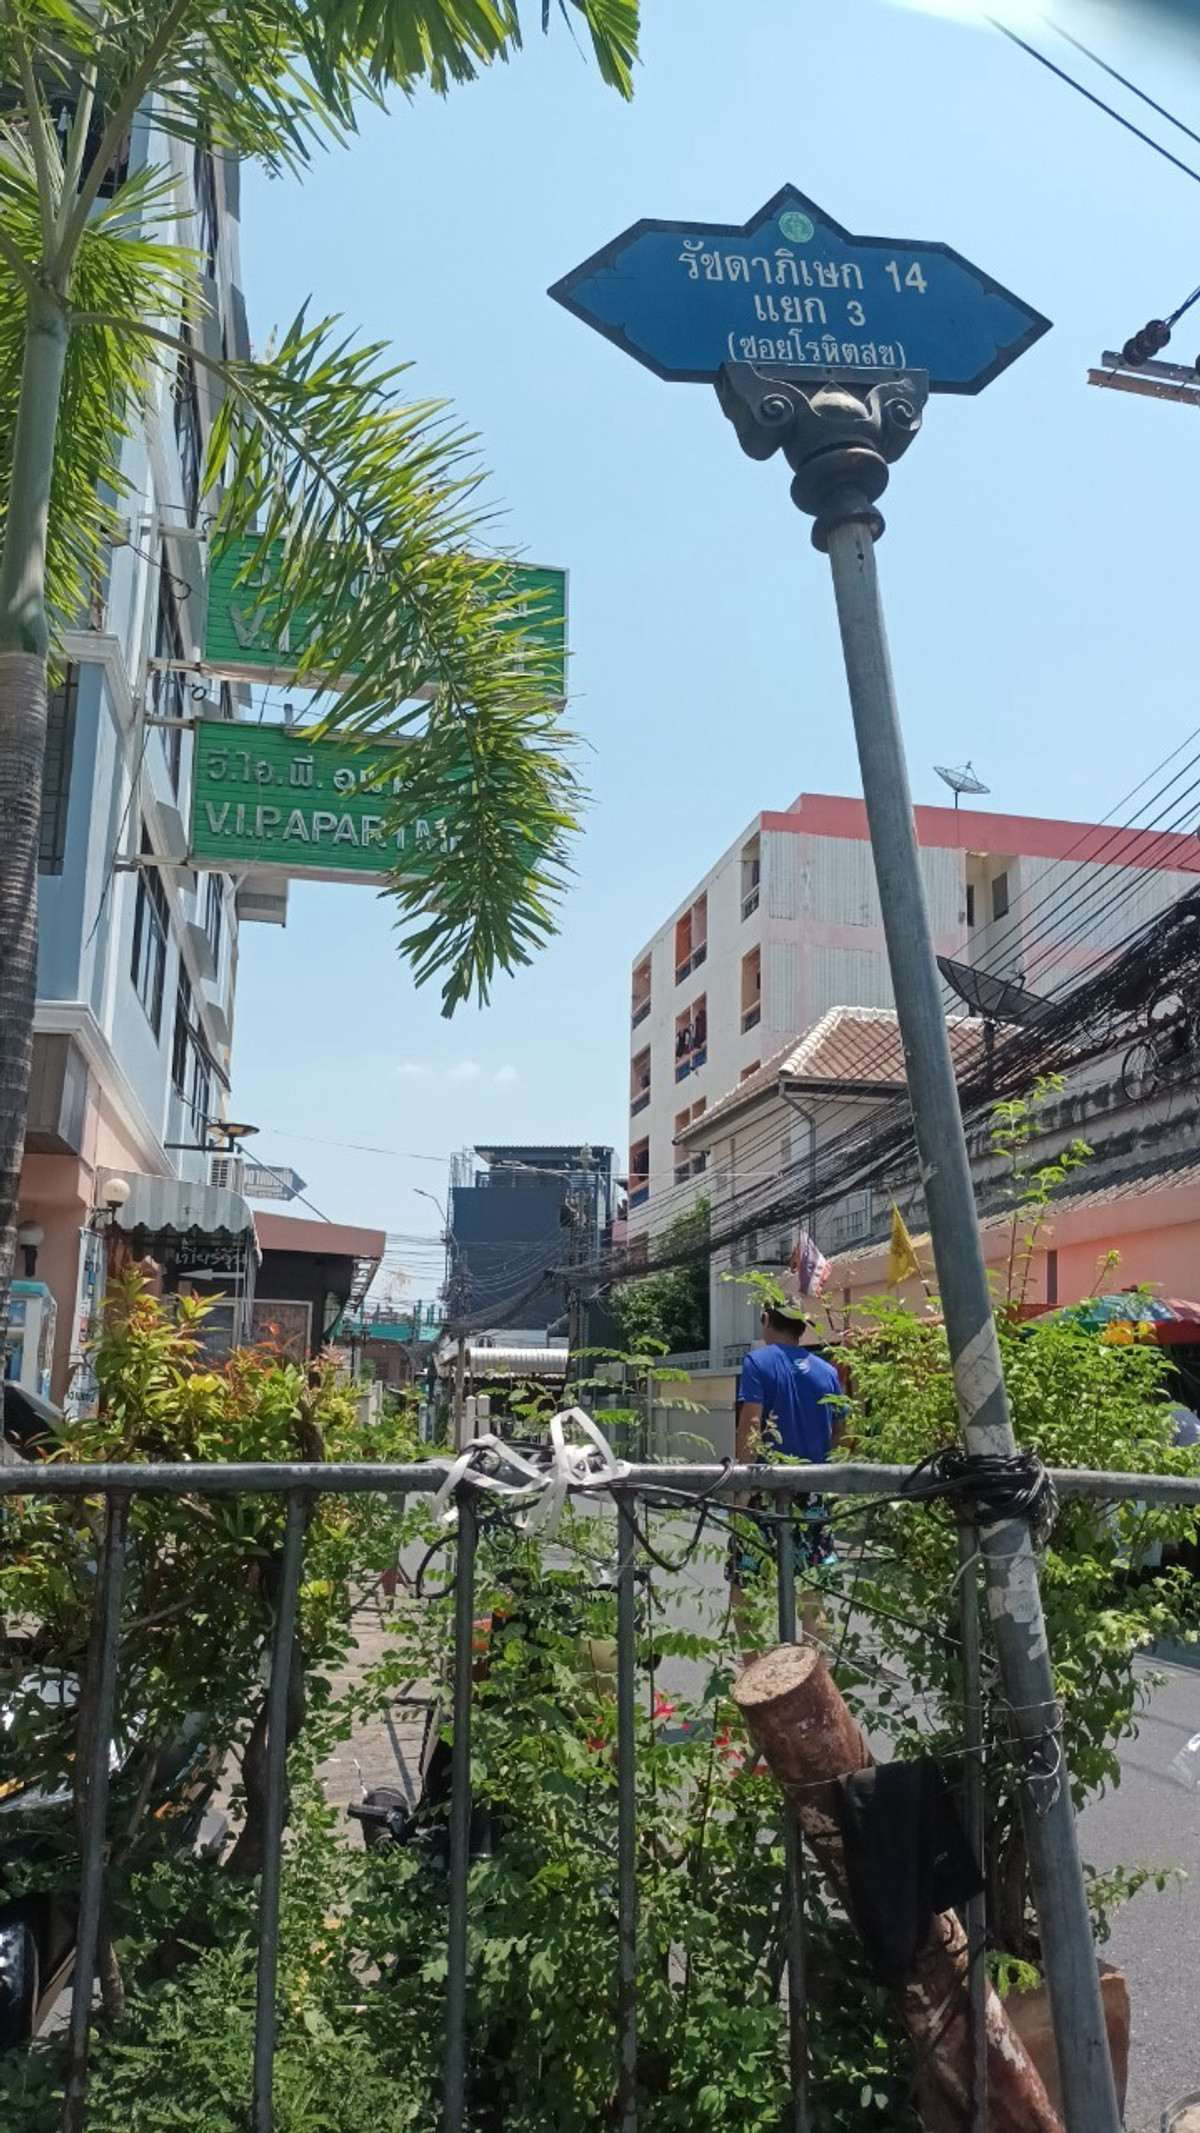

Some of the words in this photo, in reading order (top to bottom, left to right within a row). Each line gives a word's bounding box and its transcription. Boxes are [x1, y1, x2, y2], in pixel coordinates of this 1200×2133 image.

[678, 239, 865, 290] รัชดาภิเษก
[885, 260, 928, 294] 14
[753, 294, 828, 324] แยก
[846, 301, 867, 327] 3
[727, 328, 907, 370] (ซอยโรหิตสข)
